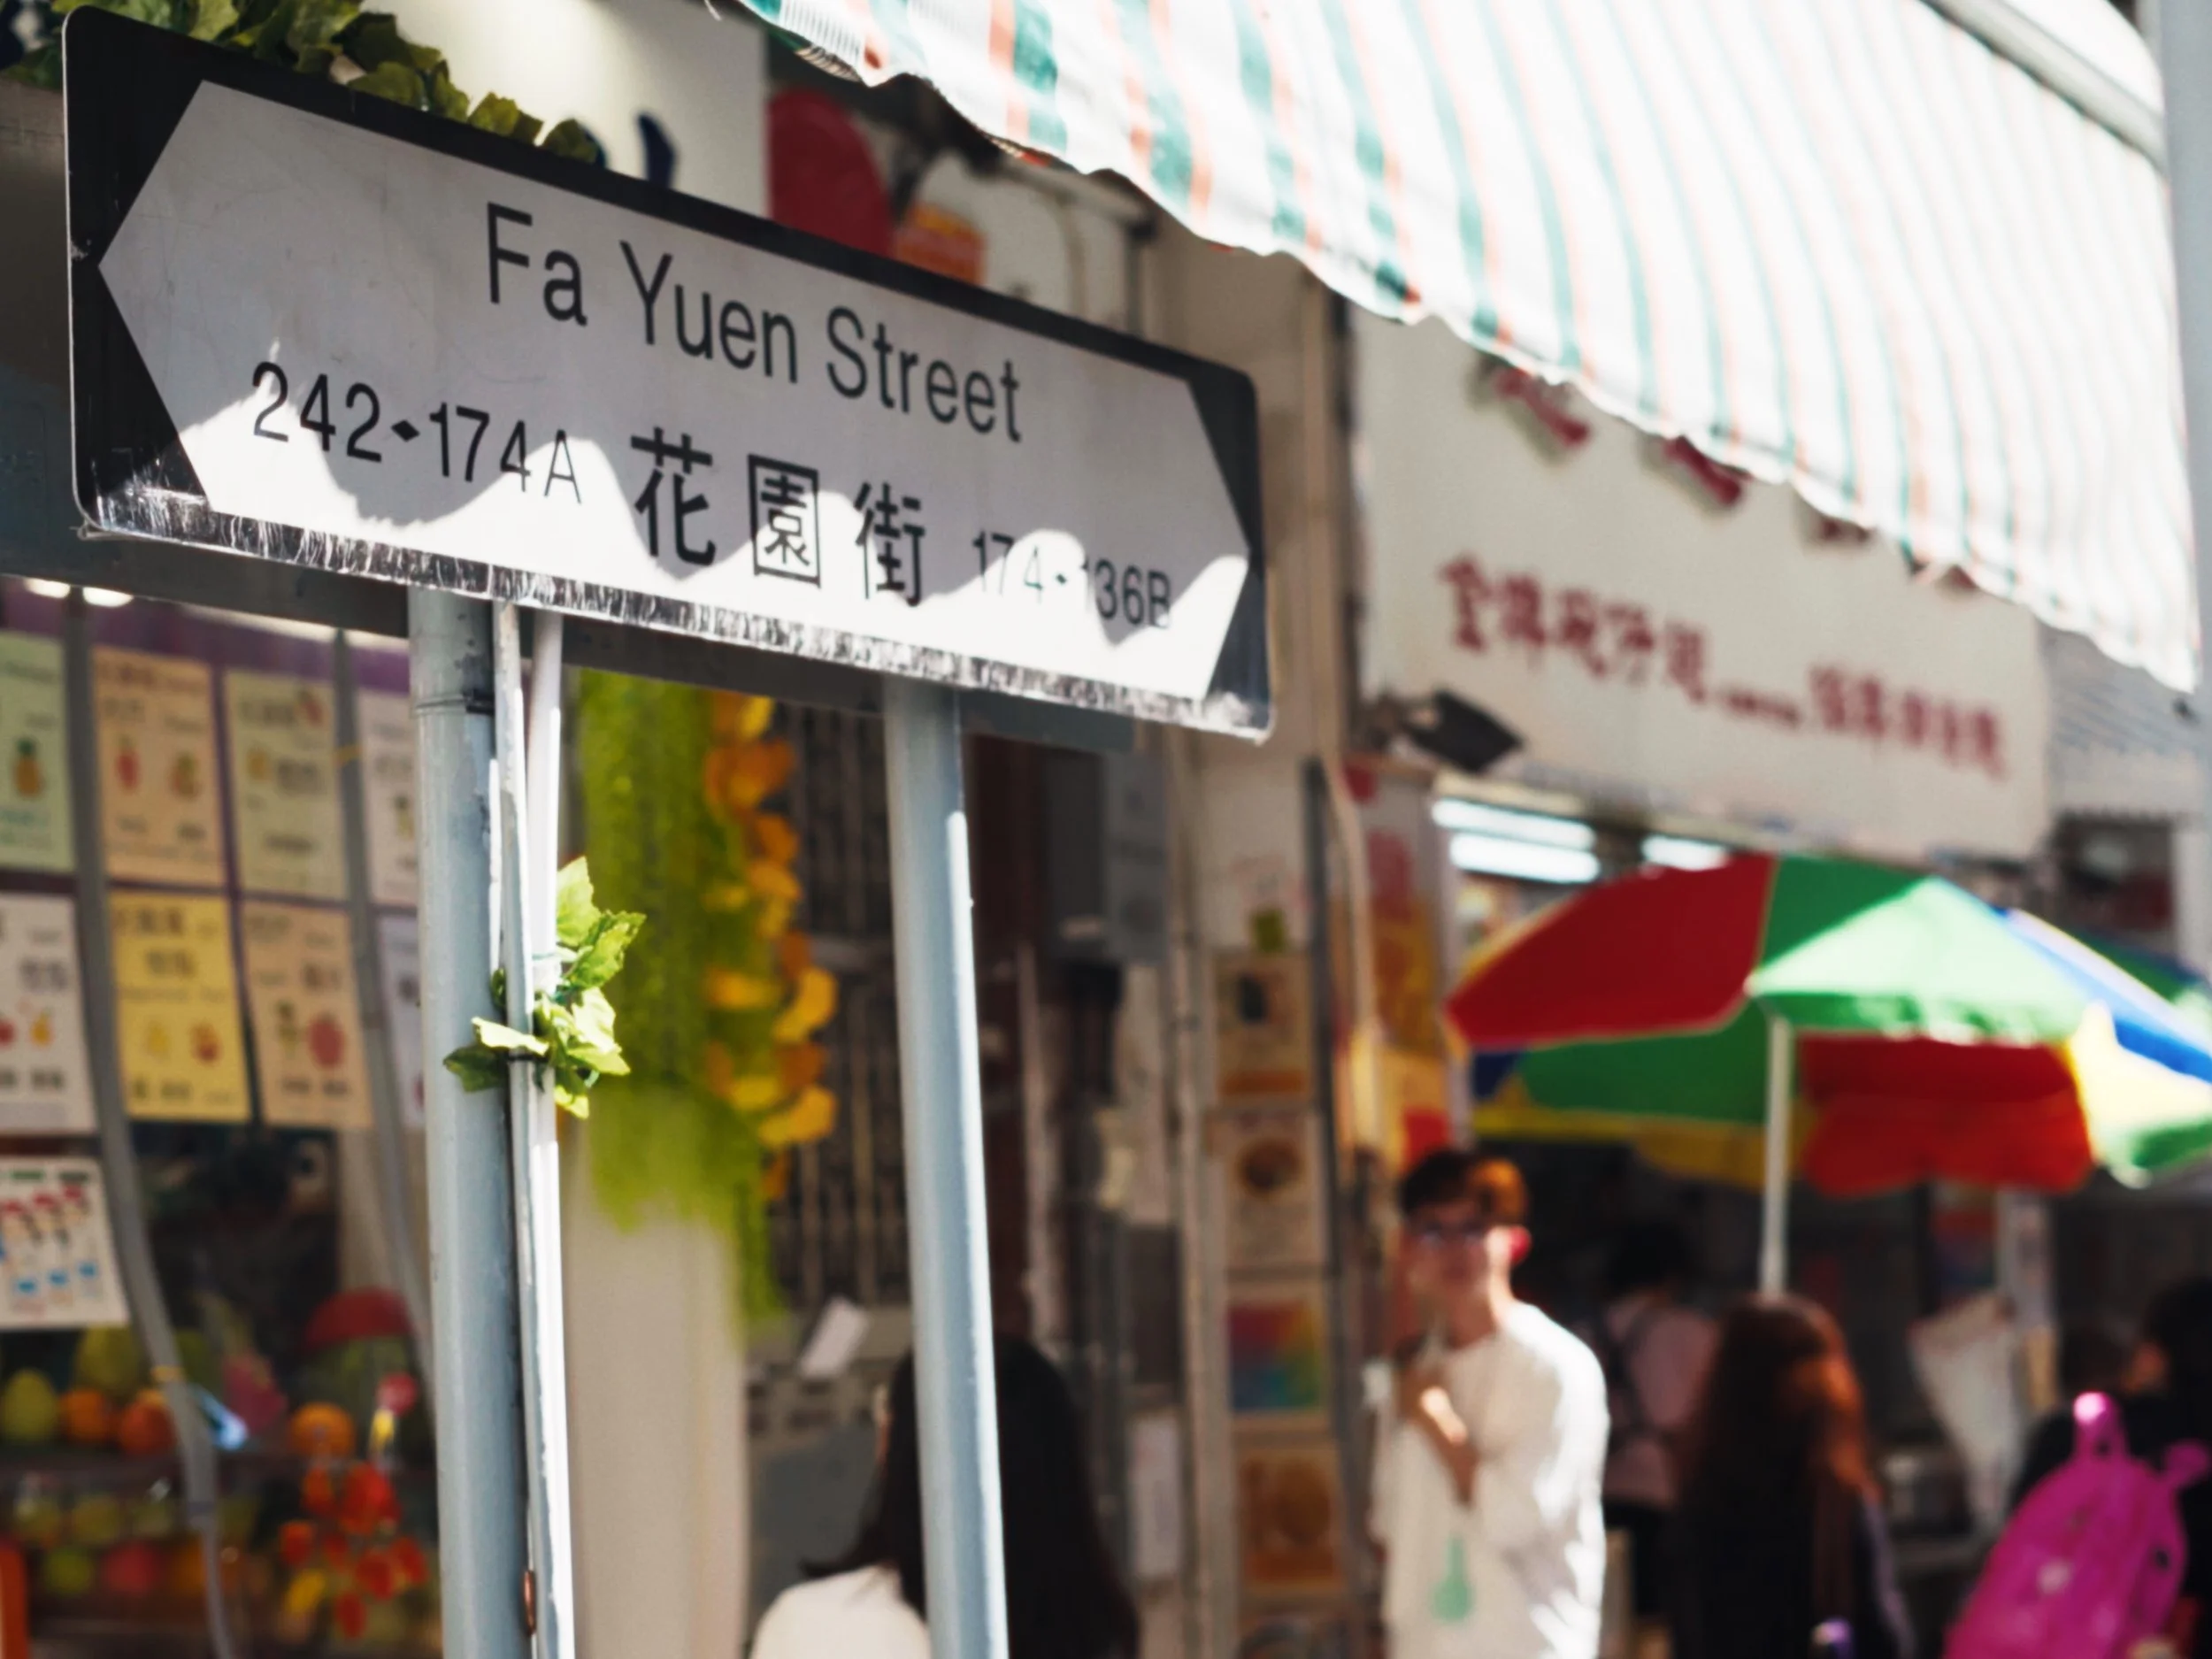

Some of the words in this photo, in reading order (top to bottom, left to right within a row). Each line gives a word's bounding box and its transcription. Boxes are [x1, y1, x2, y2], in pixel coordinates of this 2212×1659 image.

[487, 202, 588, 326] Fa
[619, 240, 798, 384] Yuen
[826, 306, 1021, 444] Street
[630, 426, 926, 607] 花園街
